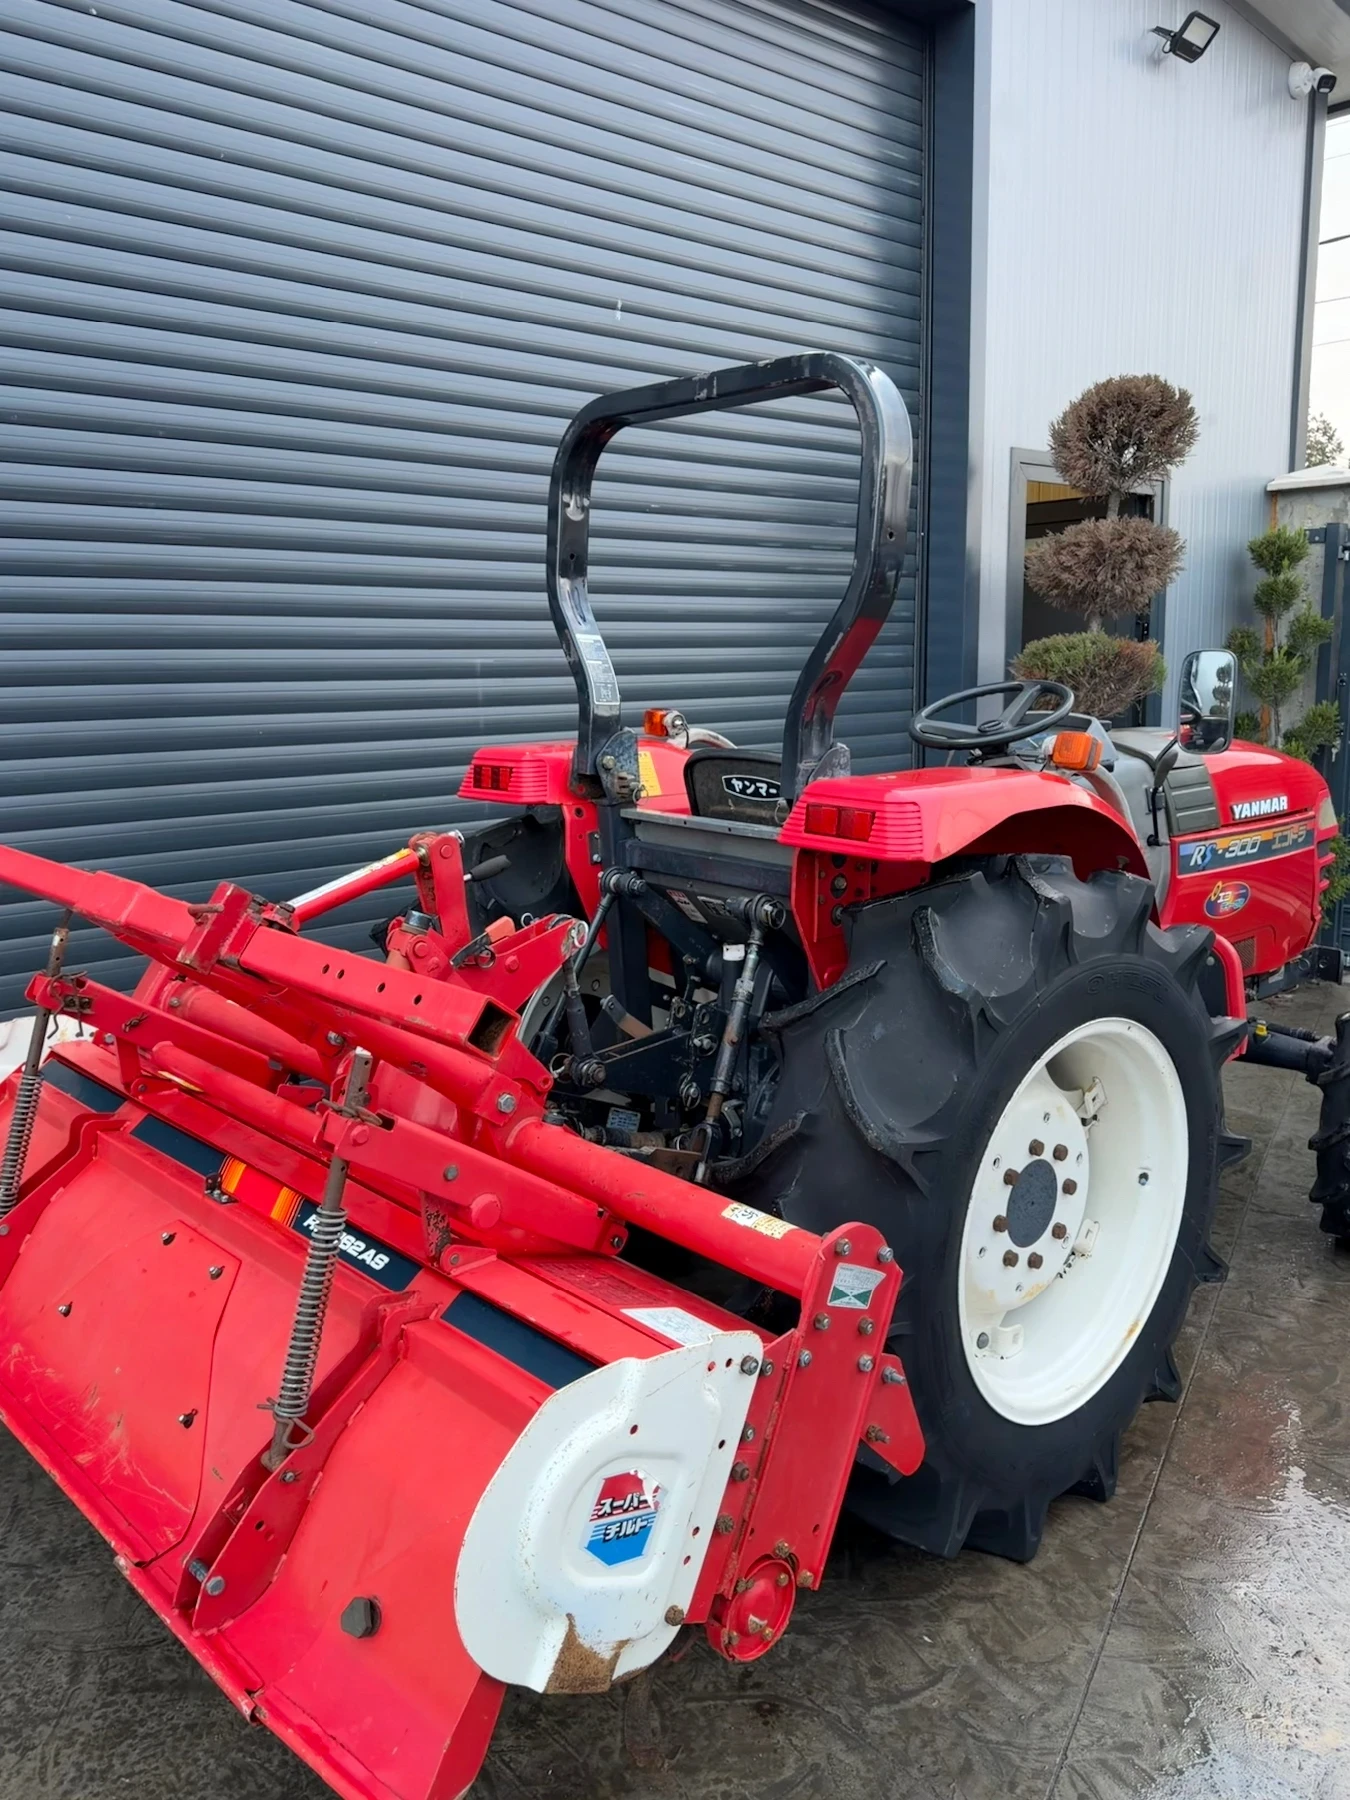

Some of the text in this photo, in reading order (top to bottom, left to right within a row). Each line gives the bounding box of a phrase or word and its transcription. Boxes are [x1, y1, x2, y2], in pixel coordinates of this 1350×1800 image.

[731, 778, 777, 796] ヤンマー
[1231, 796, 1288, 819] YANMAR
[603, 1518, 649, 1541] チルト
